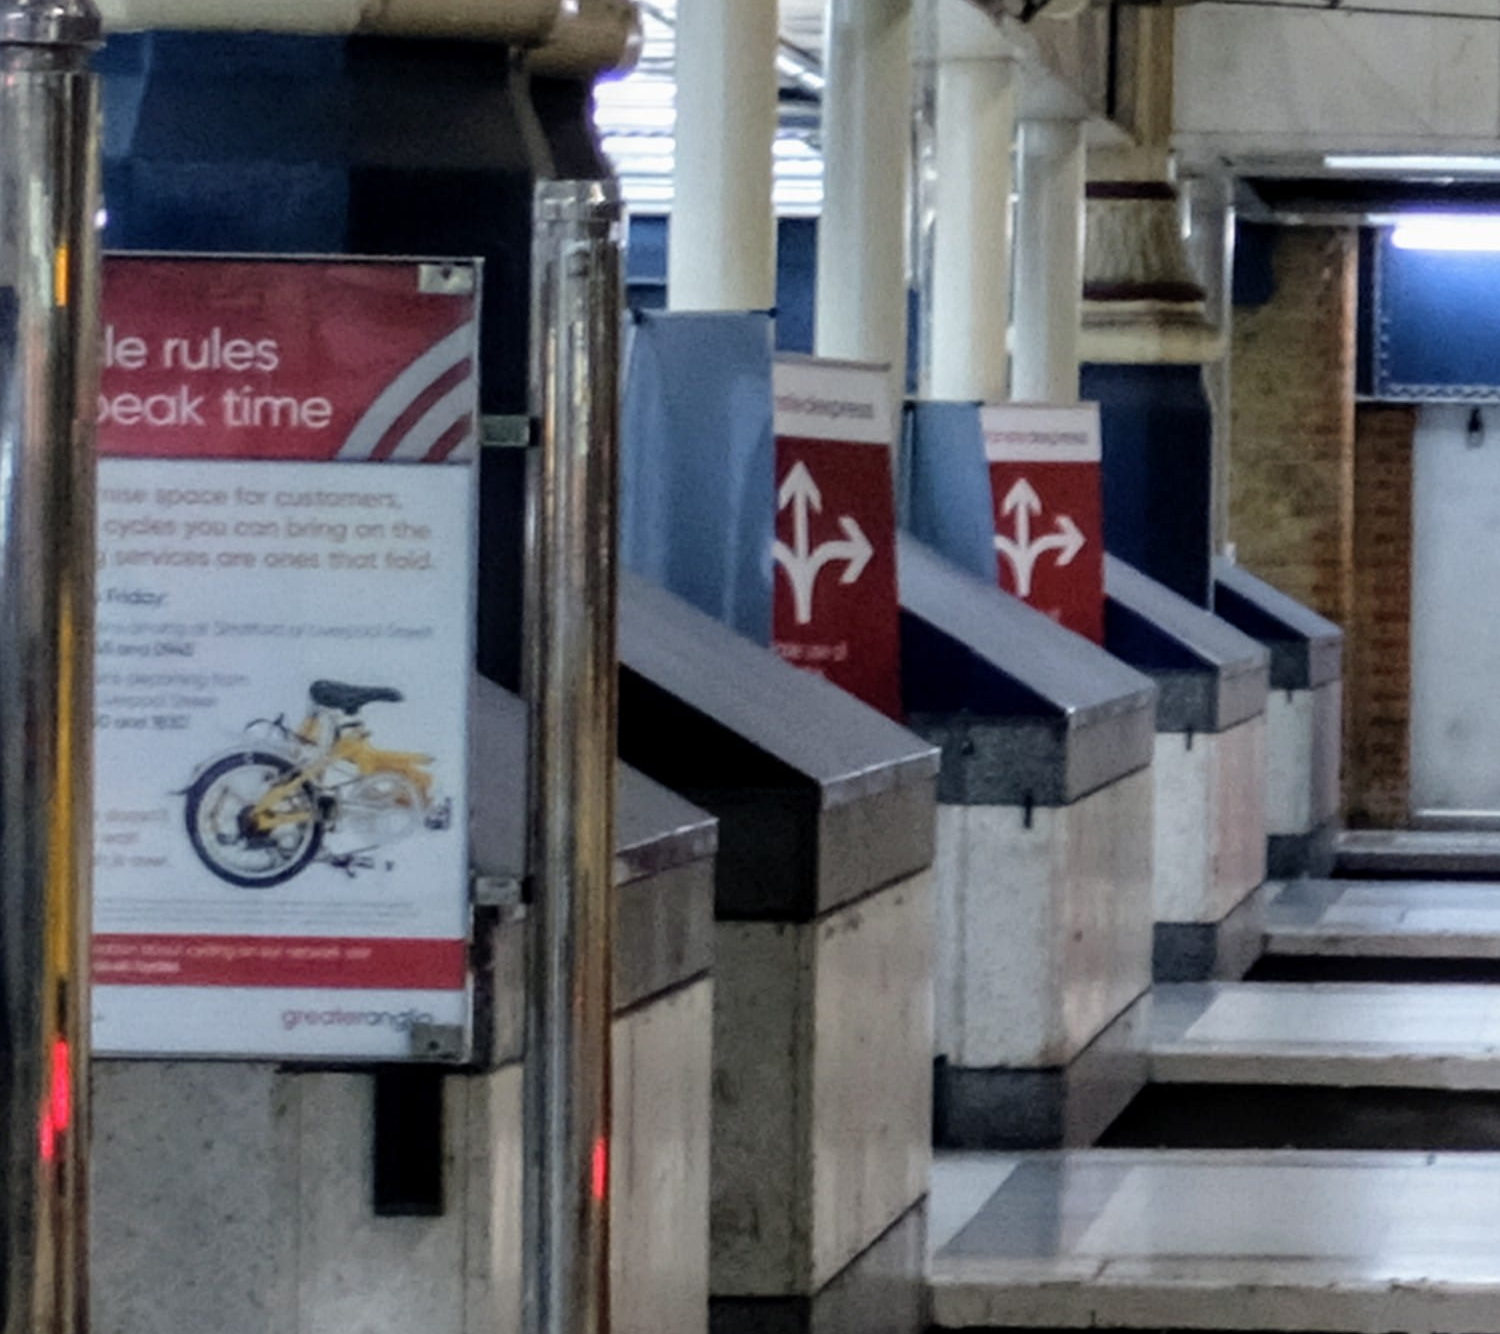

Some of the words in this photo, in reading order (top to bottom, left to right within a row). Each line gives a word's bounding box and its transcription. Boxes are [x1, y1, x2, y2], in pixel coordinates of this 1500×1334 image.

[163, 326, 280, 372] rules
[222, 385, 334, 429] time
[155, 488, 229, 510] space
[235, 485, 267, 506] for
[184, 521, 228, 541] you
[355, 523, 385, 540] on
[216, 551, 256, 568] are
